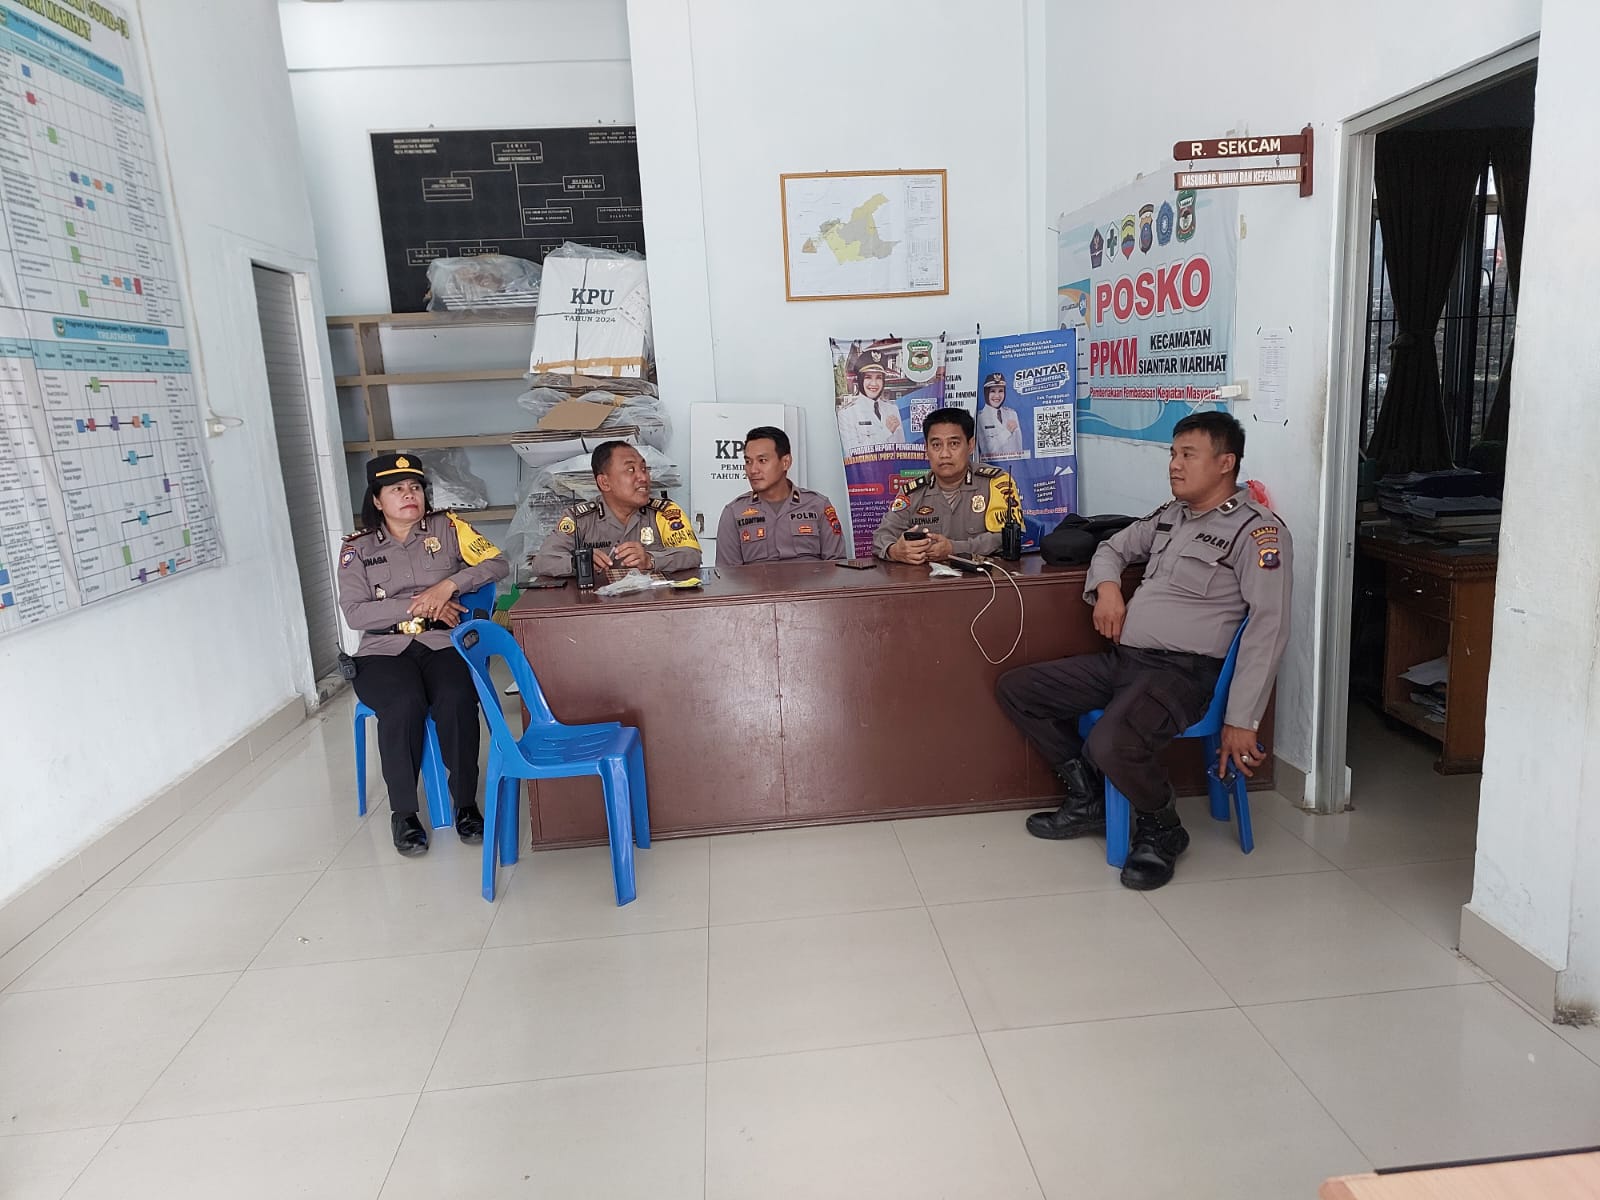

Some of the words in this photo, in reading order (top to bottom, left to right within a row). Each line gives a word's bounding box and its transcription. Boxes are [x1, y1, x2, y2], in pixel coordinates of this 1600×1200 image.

[1191, 142, 1207, 156] R.
[1218, 138, 1281, 155] SEKCAM
[1219, 172, 1239, 184] UMUM
[1240, 171, 1253, 183] DAN
[570, 287, 615, 306] KPU
[1095, 256, 1212, 326] POSKO
[563, 315, 595, 323] TAHUN
[595, 316, 616, 324] 2024
[1150, 329, 1212, 350] KECAMATAN
[1090, 337, 1138, 376] PPKM
[1138, 356, 1178, 375] SIANTAR
[1179, 354, 1227, 373] MARIHAT
[1015, 363, 1066, 380] SIANTAR
[1157, 385, 1185, 402] Kegiatan
[715, 440, 746, 459] KP
[790, 512, 817, 520] POLRI
[1194, 532, 1229, 550] POLRI
